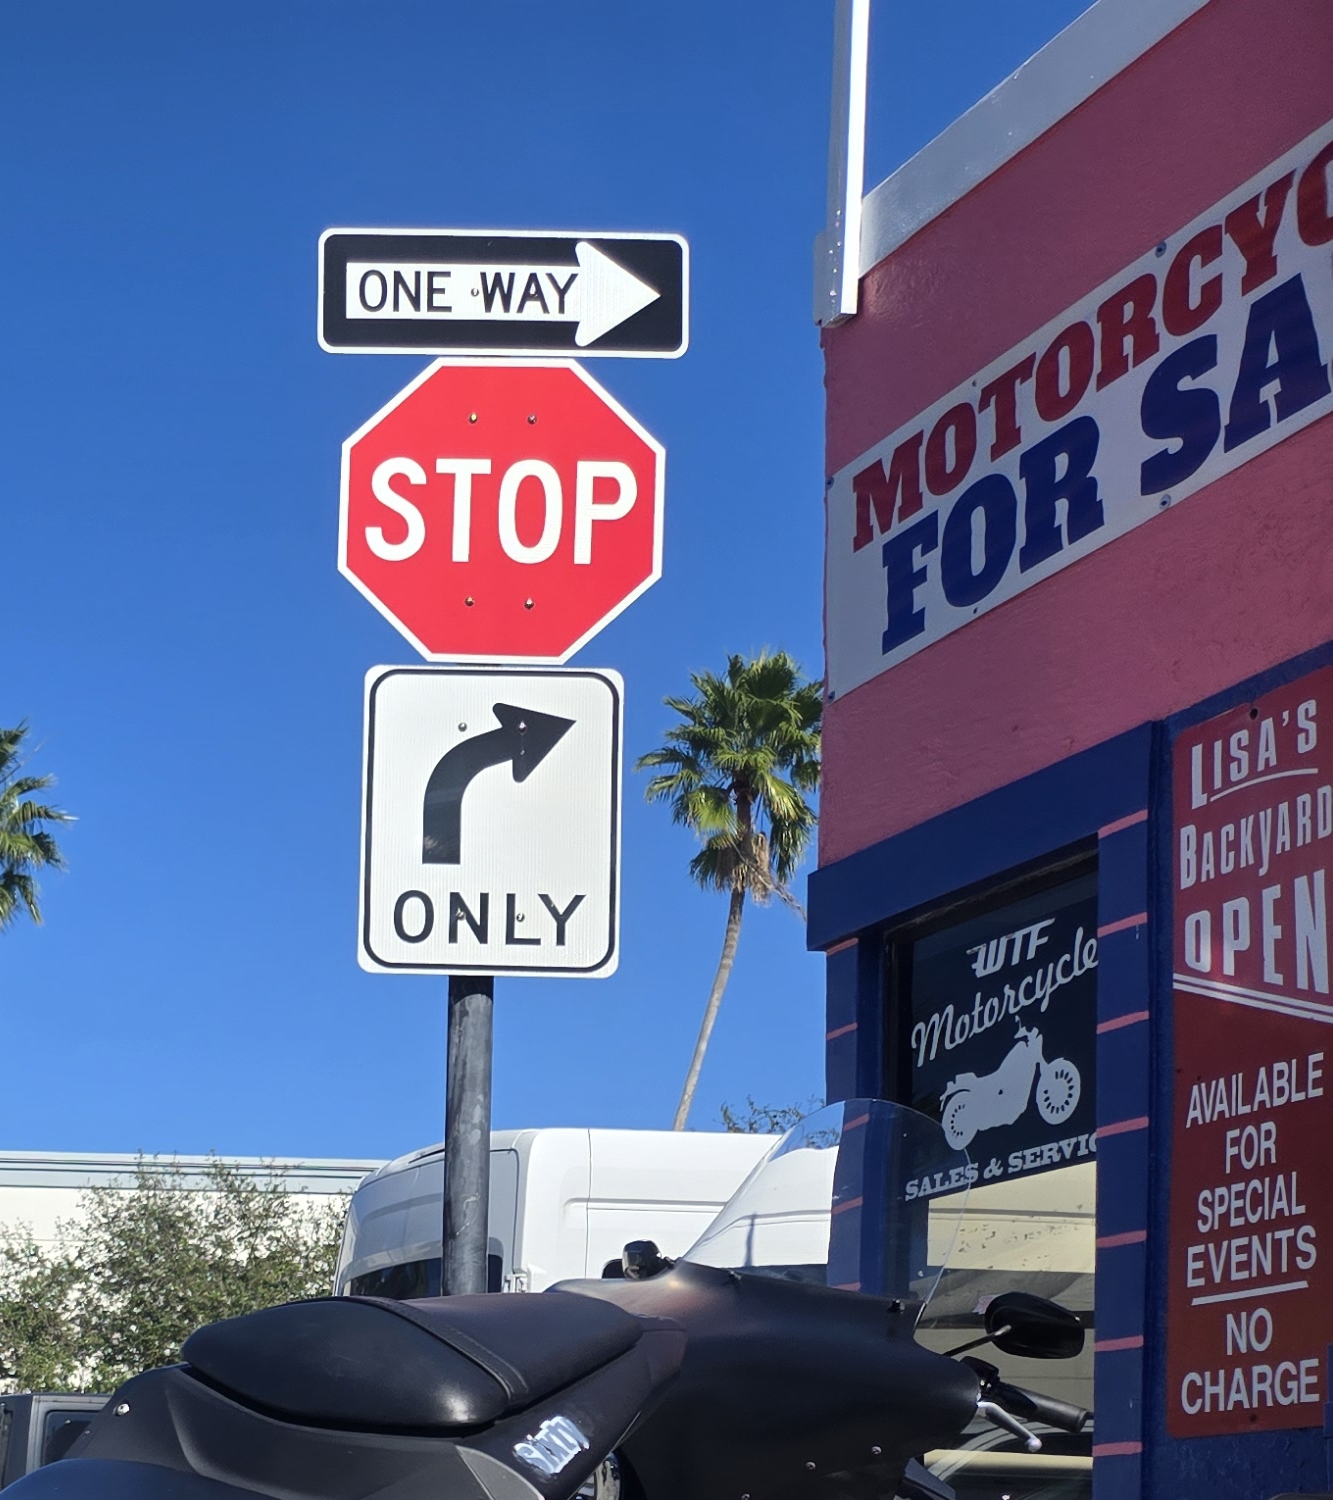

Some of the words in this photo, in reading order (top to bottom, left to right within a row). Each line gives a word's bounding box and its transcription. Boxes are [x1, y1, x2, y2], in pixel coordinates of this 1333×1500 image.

[358, 269, 452, 314] ONE
[479, 271, 579, 315] WAY
[881, 414, 1106, 656] FOR
[1138, 272, 1331, 497] SA
[363, 456, 638, 566] STOP
[392, 889, 587, 948] ONLY
[965, 917, 1056, 979] WTF
[1184, 868, 1330, 995] OPEN
[910, 926, 1099, 1068] Motorcycle
[1185, 1051, 1325, 1129] AVAILABLE
[1225, 1120, 1277, 1175] FOR
[904, 1161, 980, 1202] SALES
[983, 1158, 1004, 1181] &
[1196, 1170, 1307, 1234] SPECIAL
[1186, 1224, 1318, 1289] EVENTS
[1226, 1307, 1274, 1356] NO
[1181, 1357, 1321, 1416] CHARGE
